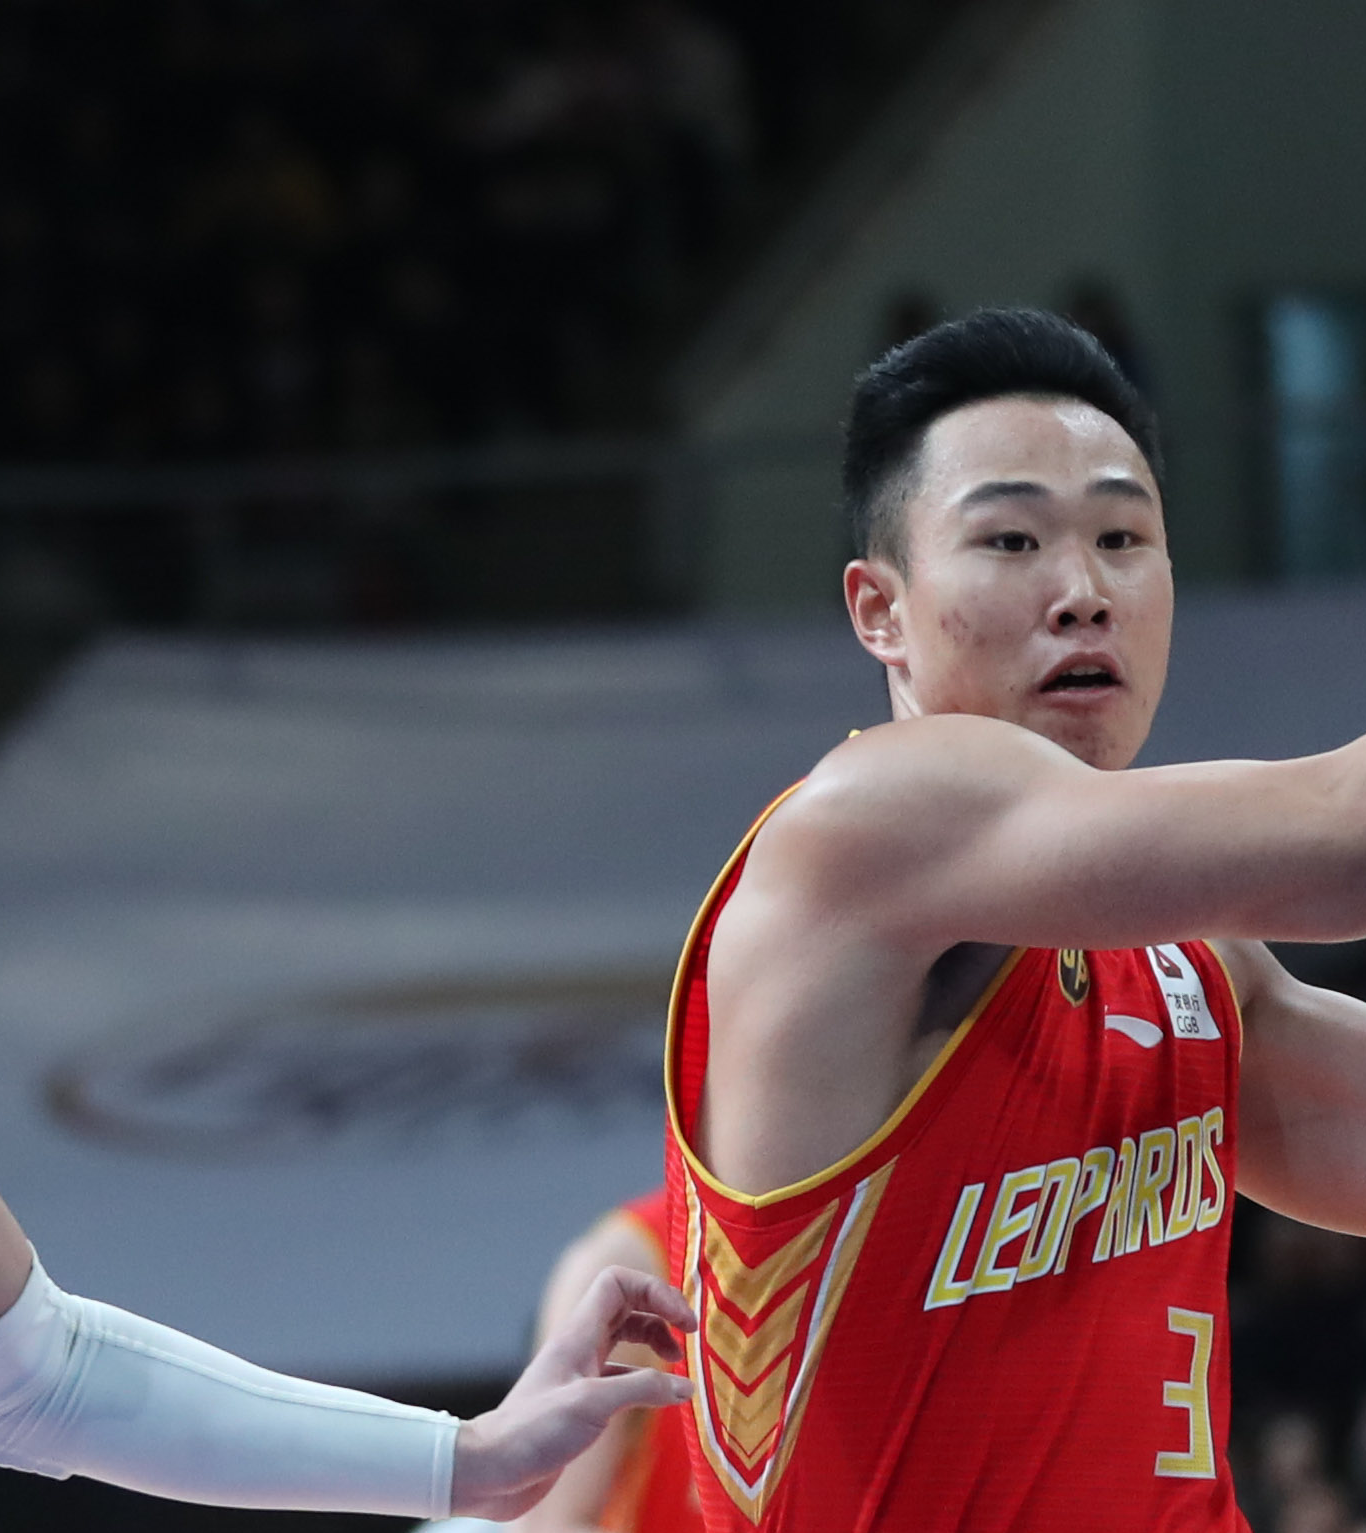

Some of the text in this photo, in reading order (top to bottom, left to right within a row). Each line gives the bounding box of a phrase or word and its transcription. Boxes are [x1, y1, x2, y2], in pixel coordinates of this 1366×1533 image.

[1176, 1015, 1200, 1033] CGB
[923, 1106, 1226, 1312] LEOPARDS
[1154, 1306, 1217, 1479] 3
